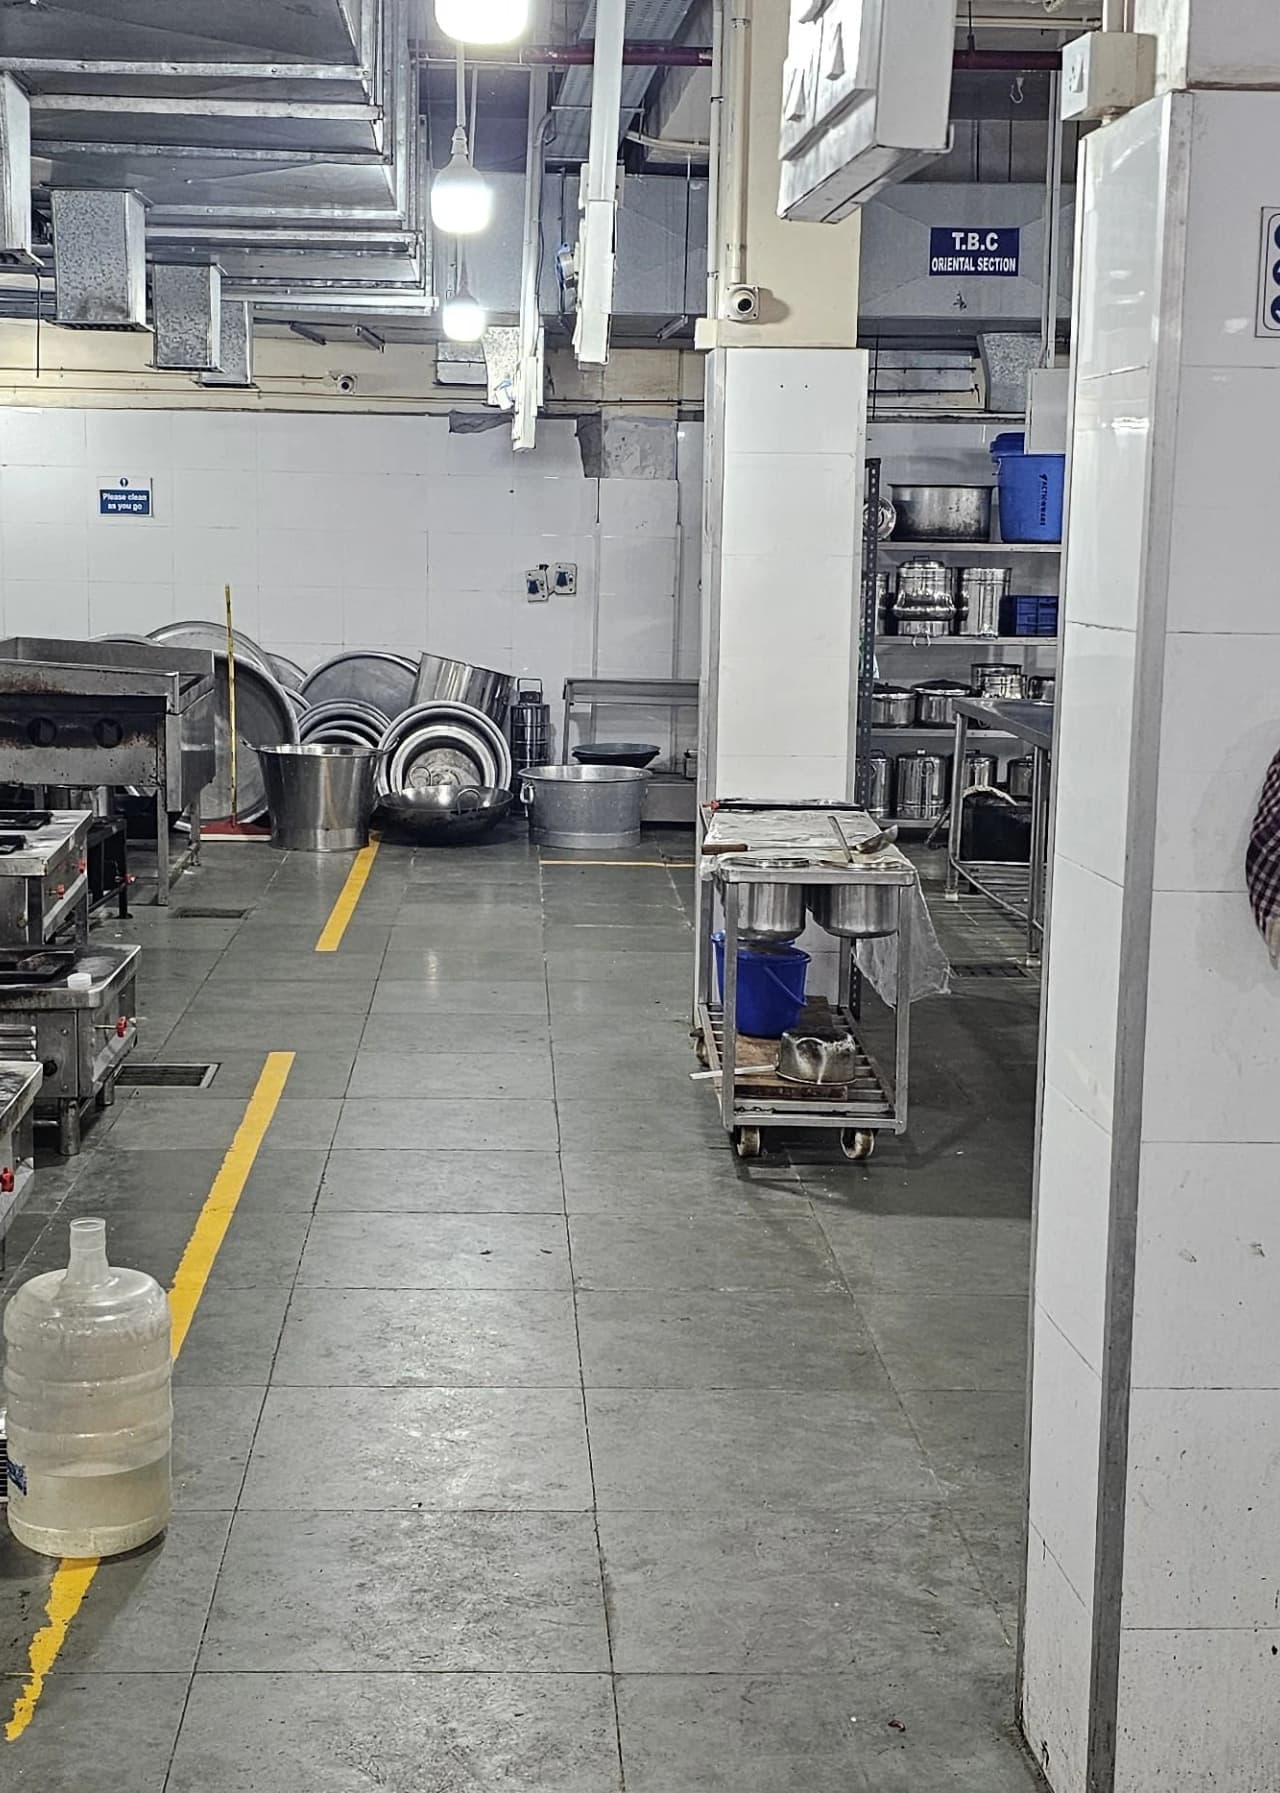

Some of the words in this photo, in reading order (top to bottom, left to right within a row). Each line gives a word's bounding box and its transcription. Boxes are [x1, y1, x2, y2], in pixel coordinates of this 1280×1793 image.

[952, 232, 998, 251] T.B.C
[931, 257, 975, 272] ORIENTAL
[977, 257, 1016, 272] SECTION
[102, 492, 126, 501] Please
[128, 493, 148, 501] clean
[132, 504, 142, 512] go
